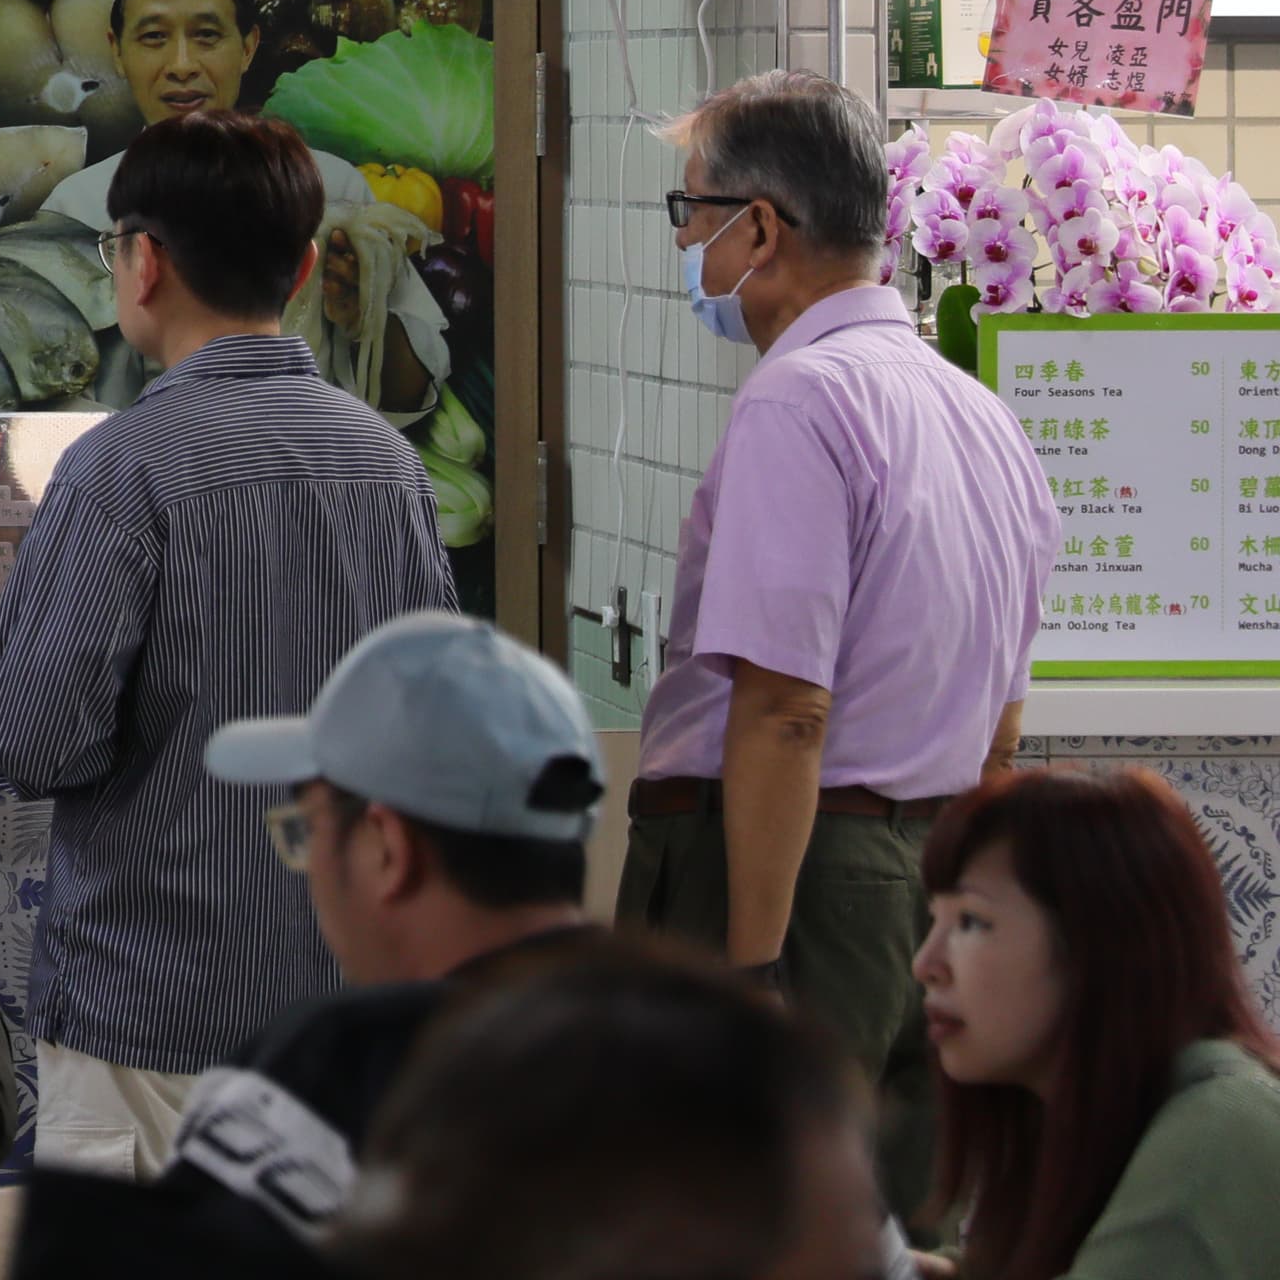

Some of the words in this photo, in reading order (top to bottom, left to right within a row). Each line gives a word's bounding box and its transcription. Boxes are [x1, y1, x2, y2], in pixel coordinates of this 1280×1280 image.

[1048, 37, 1091, 63] 女兒
[1044, 62, 1089, 88] 女婿
[1014, 360, 1086, 381] 四季春
[1191, 362, 1210, 376] 50
[1014, 387, 1041, 397] Four
[1048, 387, 1095, 397] Seasons
[1102, 387, 1123, 397] Tea
[1191, 421, 1210, 434] 50
[1034, 445, 1061, 456] mine
[1067, 446, 1089, 456] Tea
[1238, 445, 1267, 457] Dong
[1190, 480, 1210, 493] 50
[1080, 503, 1115, 514] Black
[1121, 504, 1143, 514] Tea
[1238, 503, 1253, 513] Bi
[1057, 534, 1134, 558] 山金萱
[1190, 538, 1210, 551] 60
[1052, 562, 1088, 573] nshan
[1095, 562, 1143, 573] Jinxuan
[1238, 561, 1273, 572] Mucha
[1042, 593, 1162, 616] 山高冷烏龍茶
[1191, 596, 1210, 609] 70
[1067, 620, 1109, 632] Oolong
[1115, 620, 1137, 631] Tea
